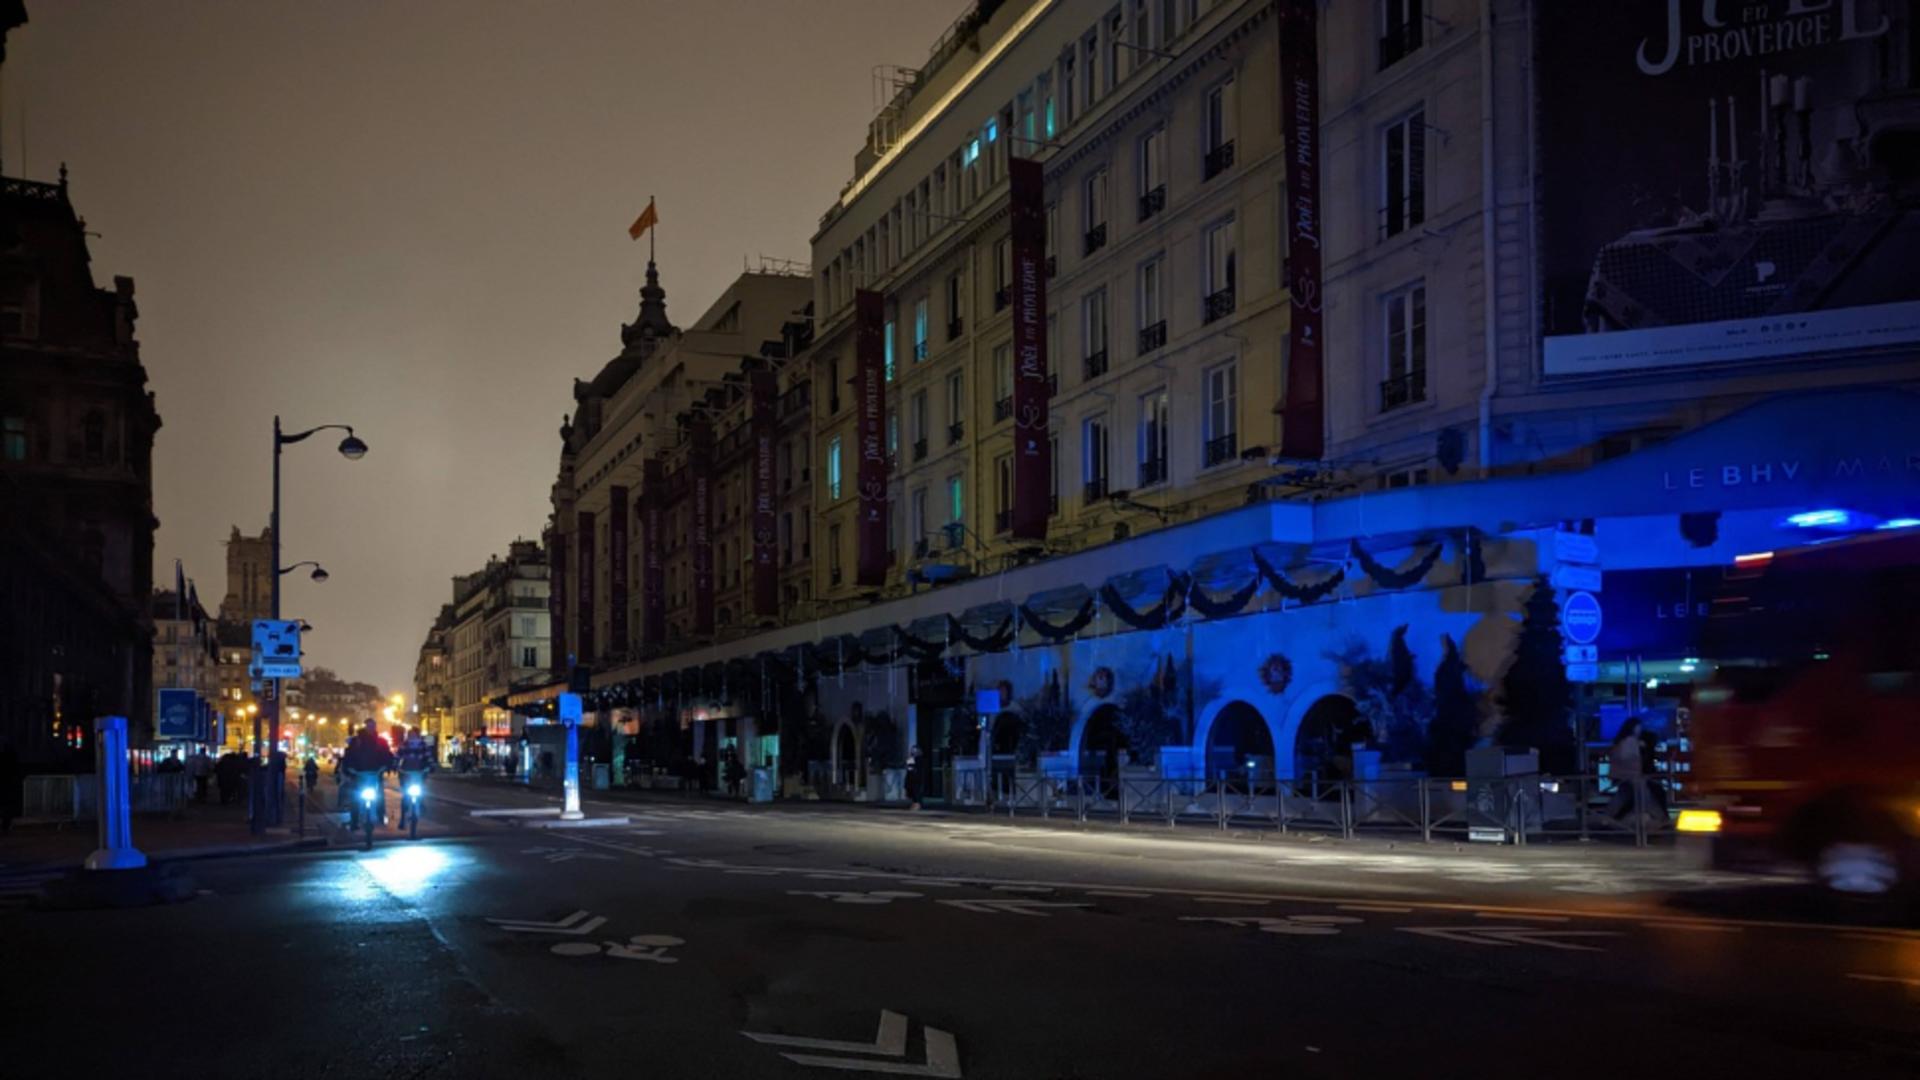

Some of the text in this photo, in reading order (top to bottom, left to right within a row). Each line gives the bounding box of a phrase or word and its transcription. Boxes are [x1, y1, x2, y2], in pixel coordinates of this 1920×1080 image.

[1687, 14, 1832, 66] PROVENCE
[1663, 468, 1705, 491] LE
[1722, 460, 1800, 486] BHV
